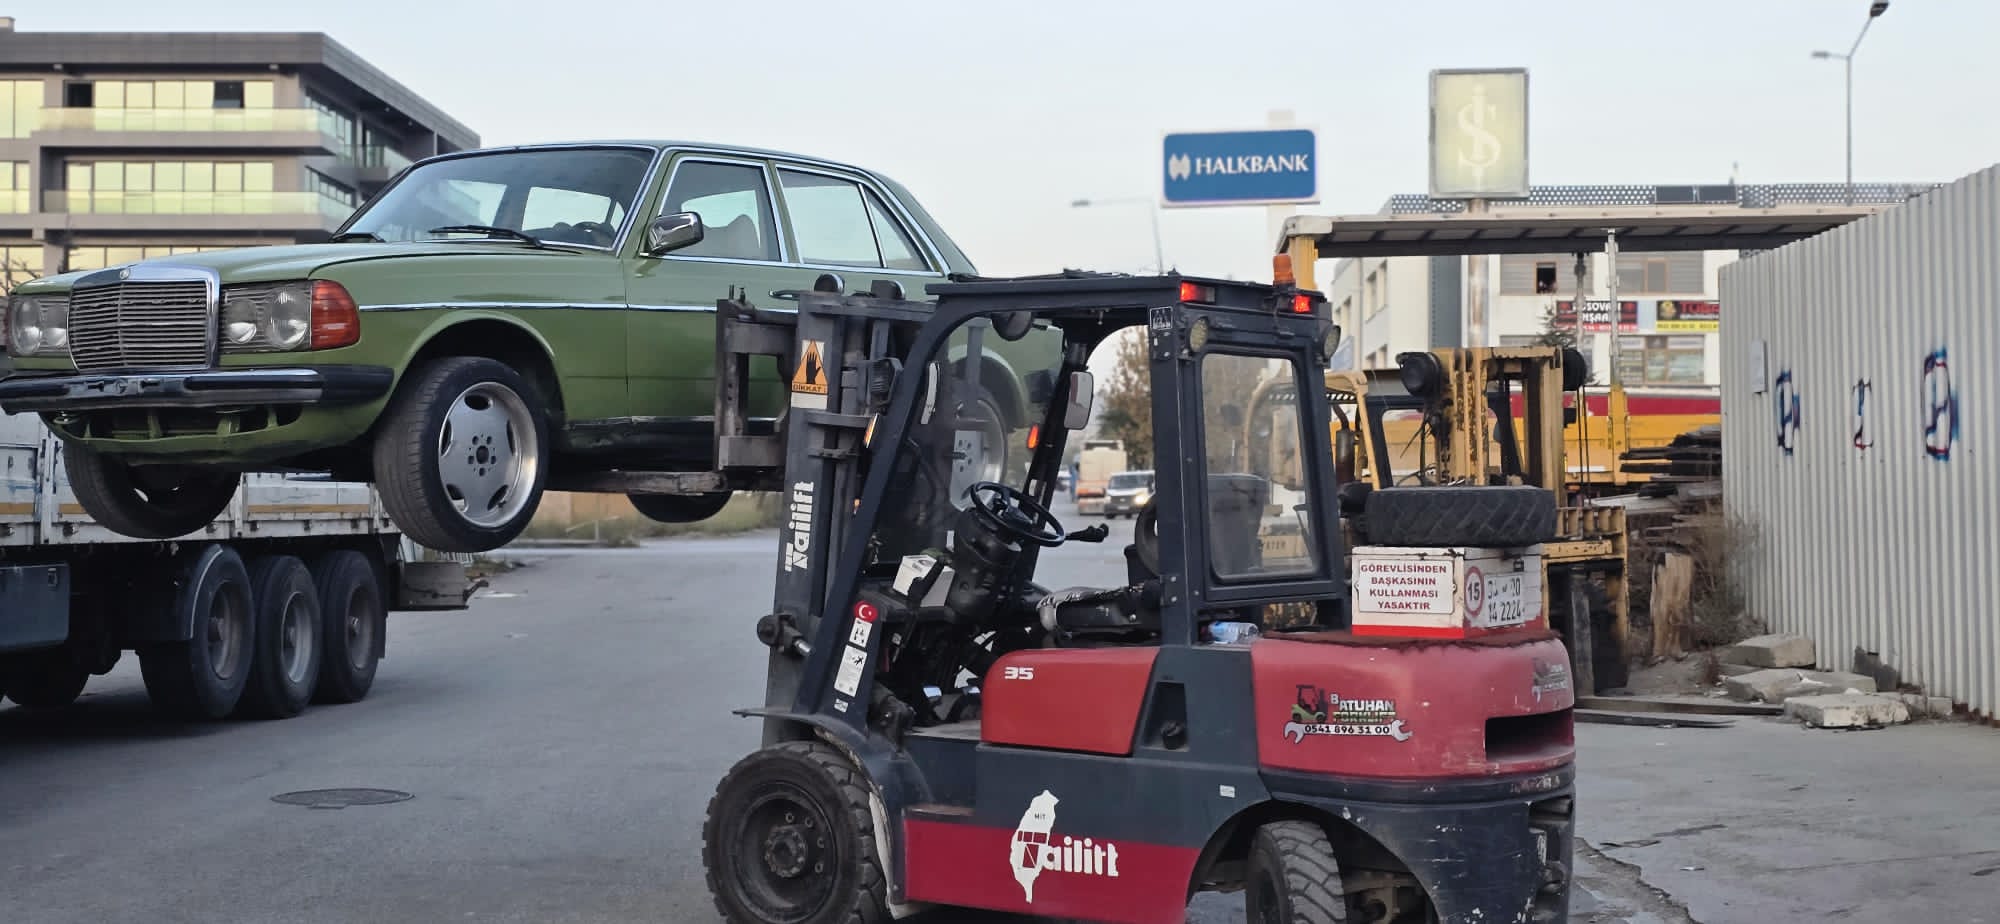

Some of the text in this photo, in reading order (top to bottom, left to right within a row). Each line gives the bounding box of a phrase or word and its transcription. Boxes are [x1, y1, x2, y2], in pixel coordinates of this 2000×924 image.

[1195, 153, 1309, 175] HALKBANK
[784, 481, 814, 572] Tailift
[1360, 563, 1447, 574] GÖREVLİSİNDEN
[1371, 576, 1436, 586] BAŞKASININ
[1369, 588, 1438, 598] KULLANMASI
[1467, 581, 1481, 601] 15
[1378, 601, 1431, 610] YASAKTIR
[1004, 666, 1034, 680] 35
[1331, 693, 1394, 711] BATUHAN
[1304, 725, 1390, 734] 0541 896 31 00
